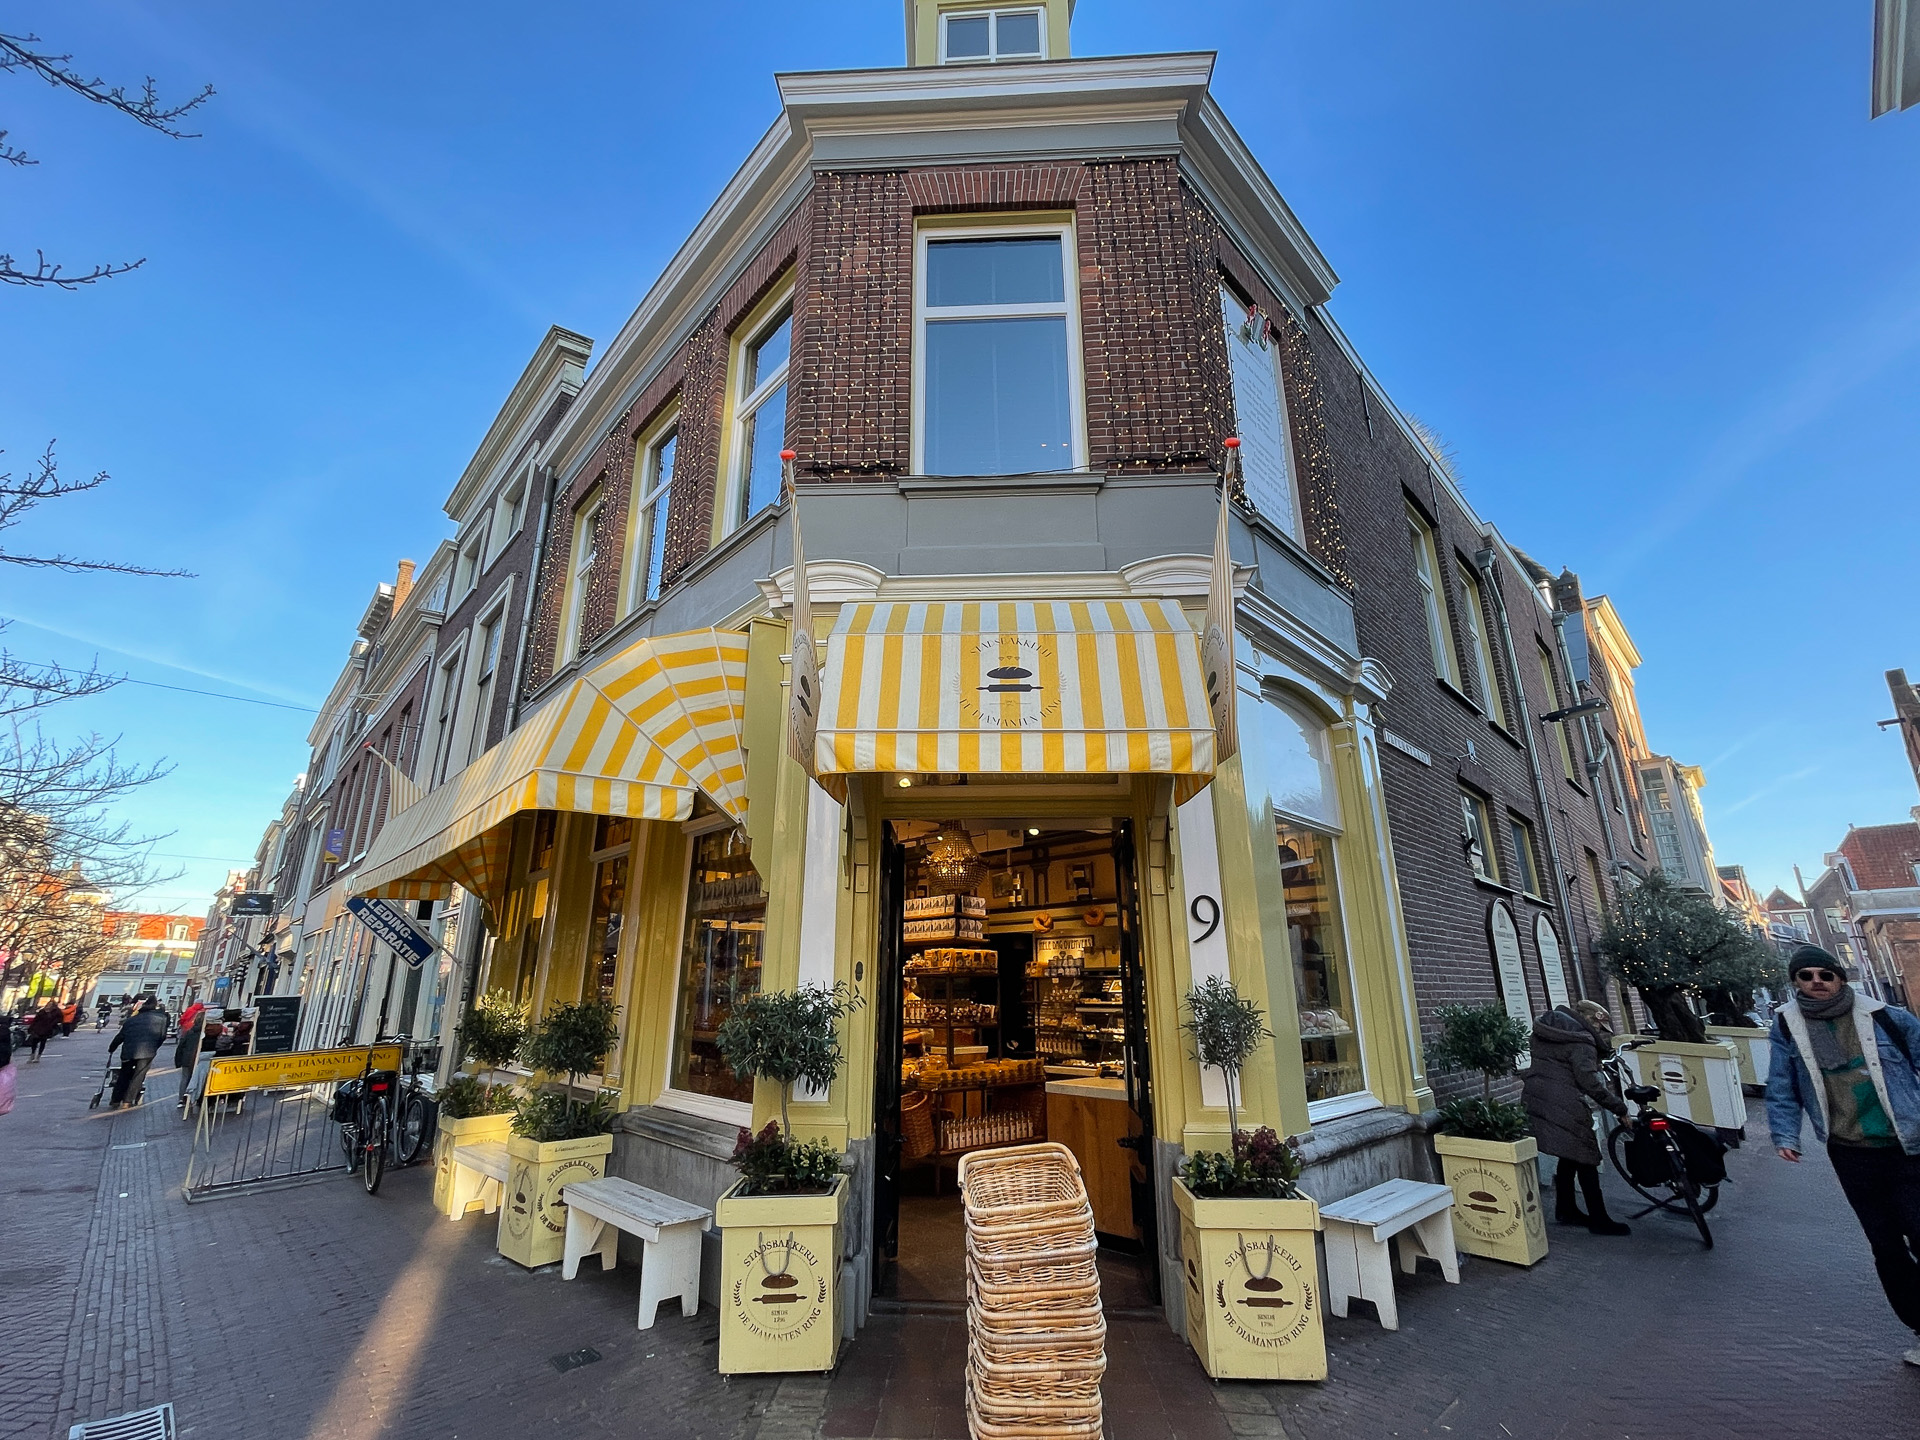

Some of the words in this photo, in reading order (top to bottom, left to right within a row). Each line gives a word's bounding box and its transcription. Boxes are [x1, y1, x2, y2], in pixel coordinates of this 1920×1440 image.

[1190, 894, 1220, 944] 9
[357, 907, 421, 964] REPARATIE
[223, 1062, 280, 1075] BAKKERIJ
[298, 1055, 362, 1068] DIAMANTEN
[370, 1053, 391, 1062] ING
[547, 1160, 599, 1183] STADSBAKKERIJ
[1452, 1166, 1511, 1192] STADSBAKKERIJ
[1463, 1220, 1506, 1240] DIAMANTEN
[1505, 1220, 1520, 1237] RING
[738, 1311, 751, 1326] DE
[748, 1323, 802, 1342] DIAMANTEN
[803, 1307, 821, 1332] RING
[1224, 1311, 1237, 1328] DE
[1235, 1326, 1291, 1348] DIAMANTEN
[1291, 1314, 1309, 1339] RING
